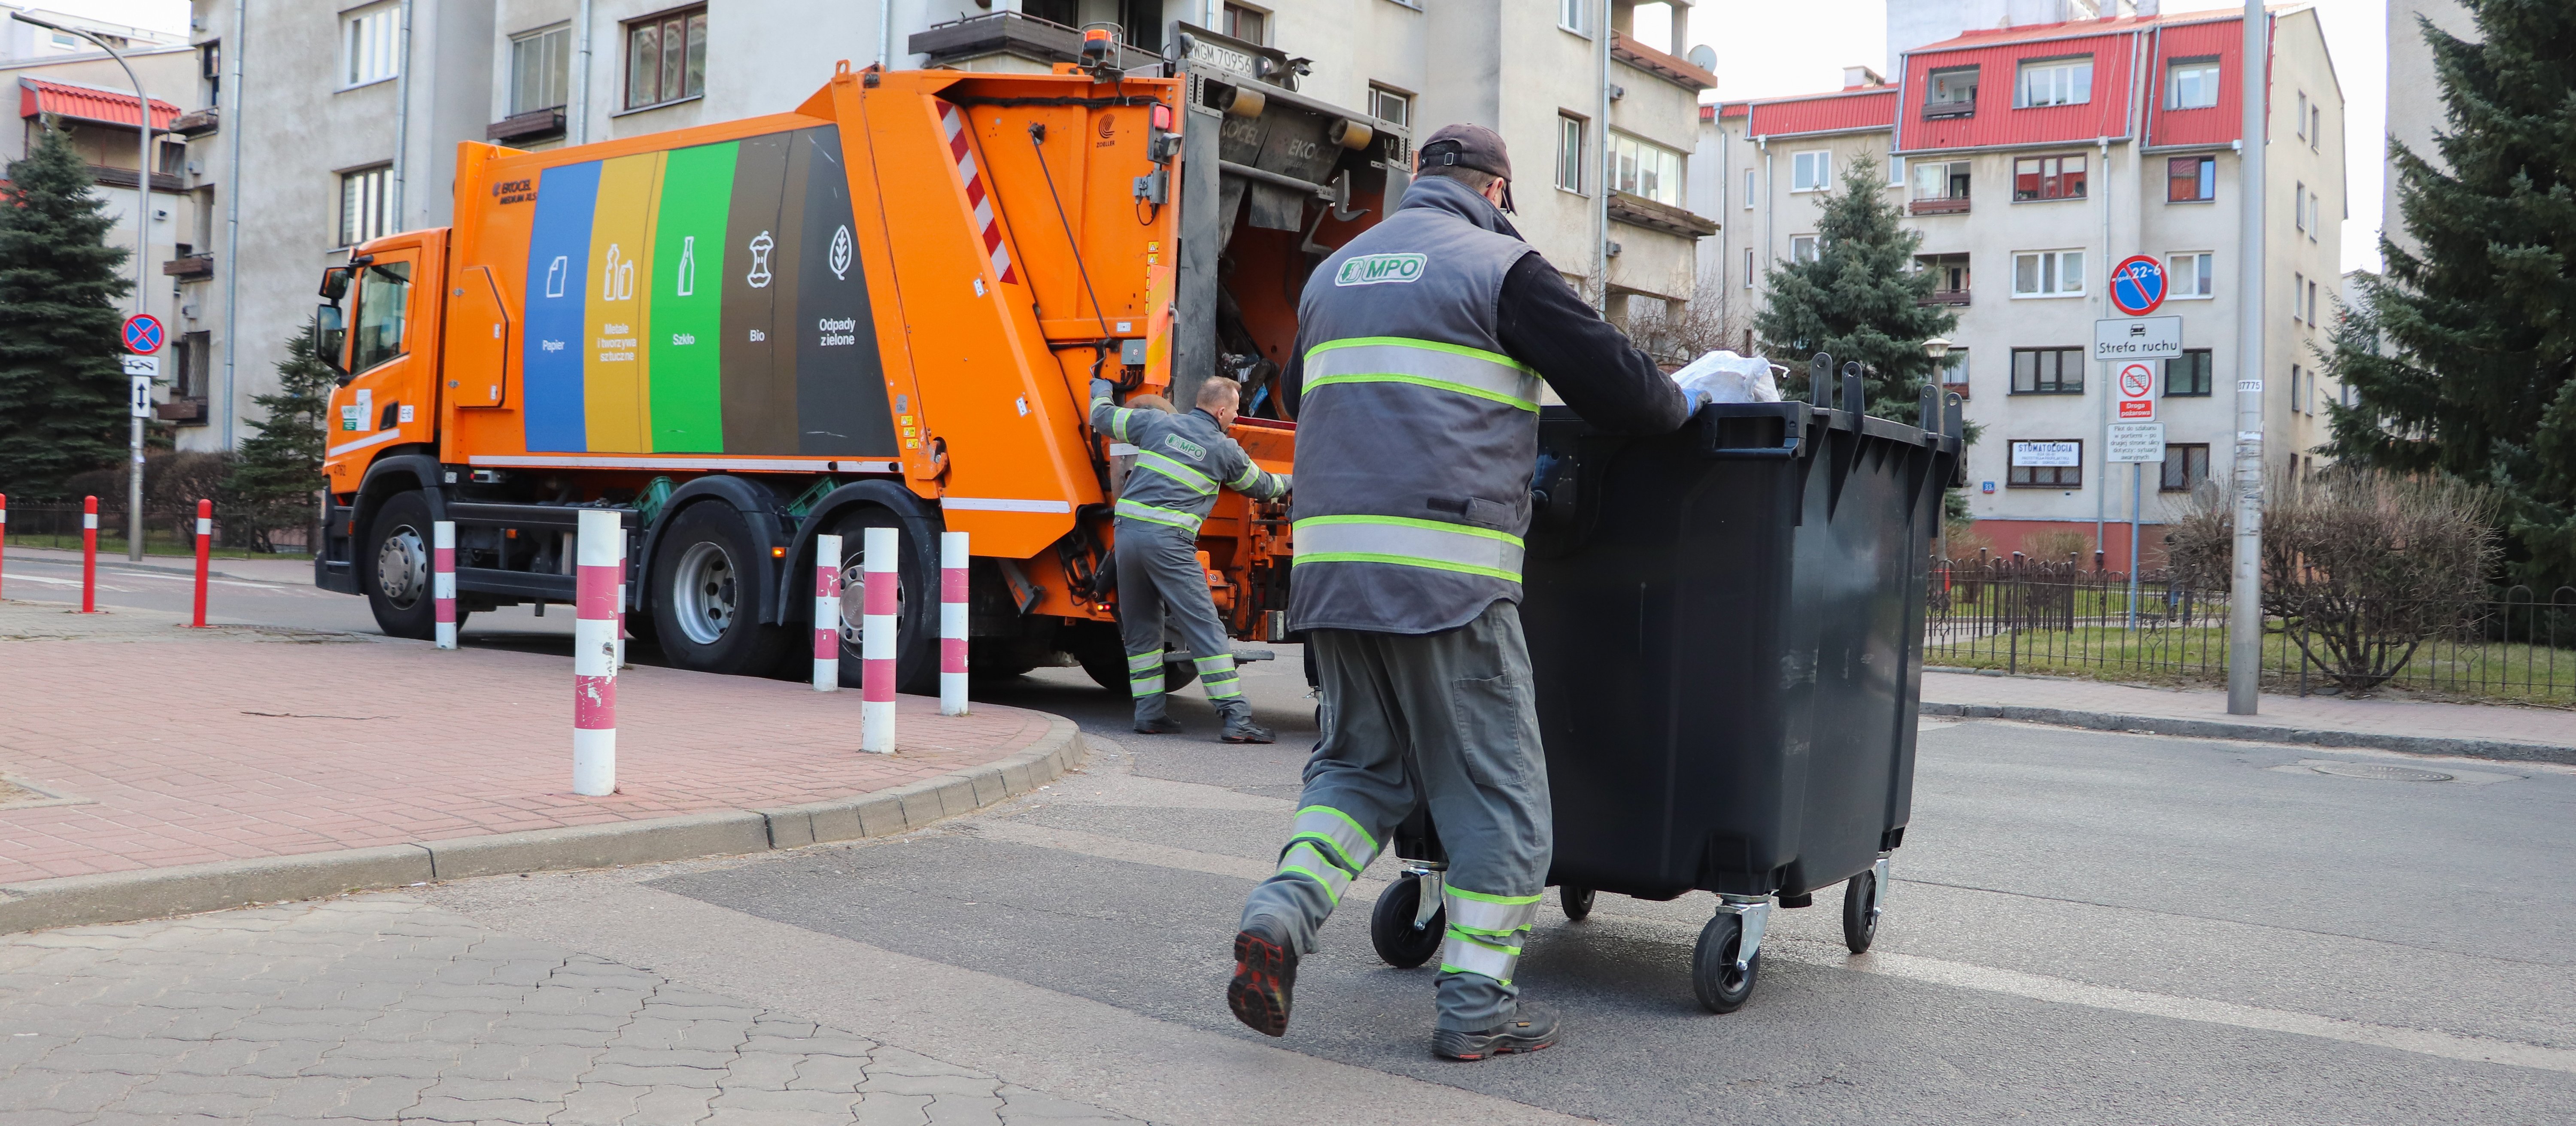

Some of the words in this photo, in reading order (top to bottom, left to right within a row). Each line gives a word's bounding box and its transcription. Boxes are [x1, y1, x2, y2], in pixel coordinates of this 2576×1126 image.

[1194, 42, 1215, 63] WGM
[1218, 49, 1252, 73] 70956
[1366, 259, 1419, 278] MPO
[2132, 263, 2162, 279] 22-6
[605, 324, 629, 334] Metale
[819, 317, 856, 333] Odpady
[673, 334, 695, 345] Szkło
[750, 329, 765, 342] Bio
[820, 334, 855, 346] zielone
[543, 339, 565, 352] Papier
[597, 338, 600, 348] i
[602, 338, 637, 350] tworzywa
[2099, 341, 2136, 353] Strefa
[2143, 340, 2177, 351] ruchu
[600, 352, 635, 361] sztuczne
[1179, 441, 1202, 457] MPO
